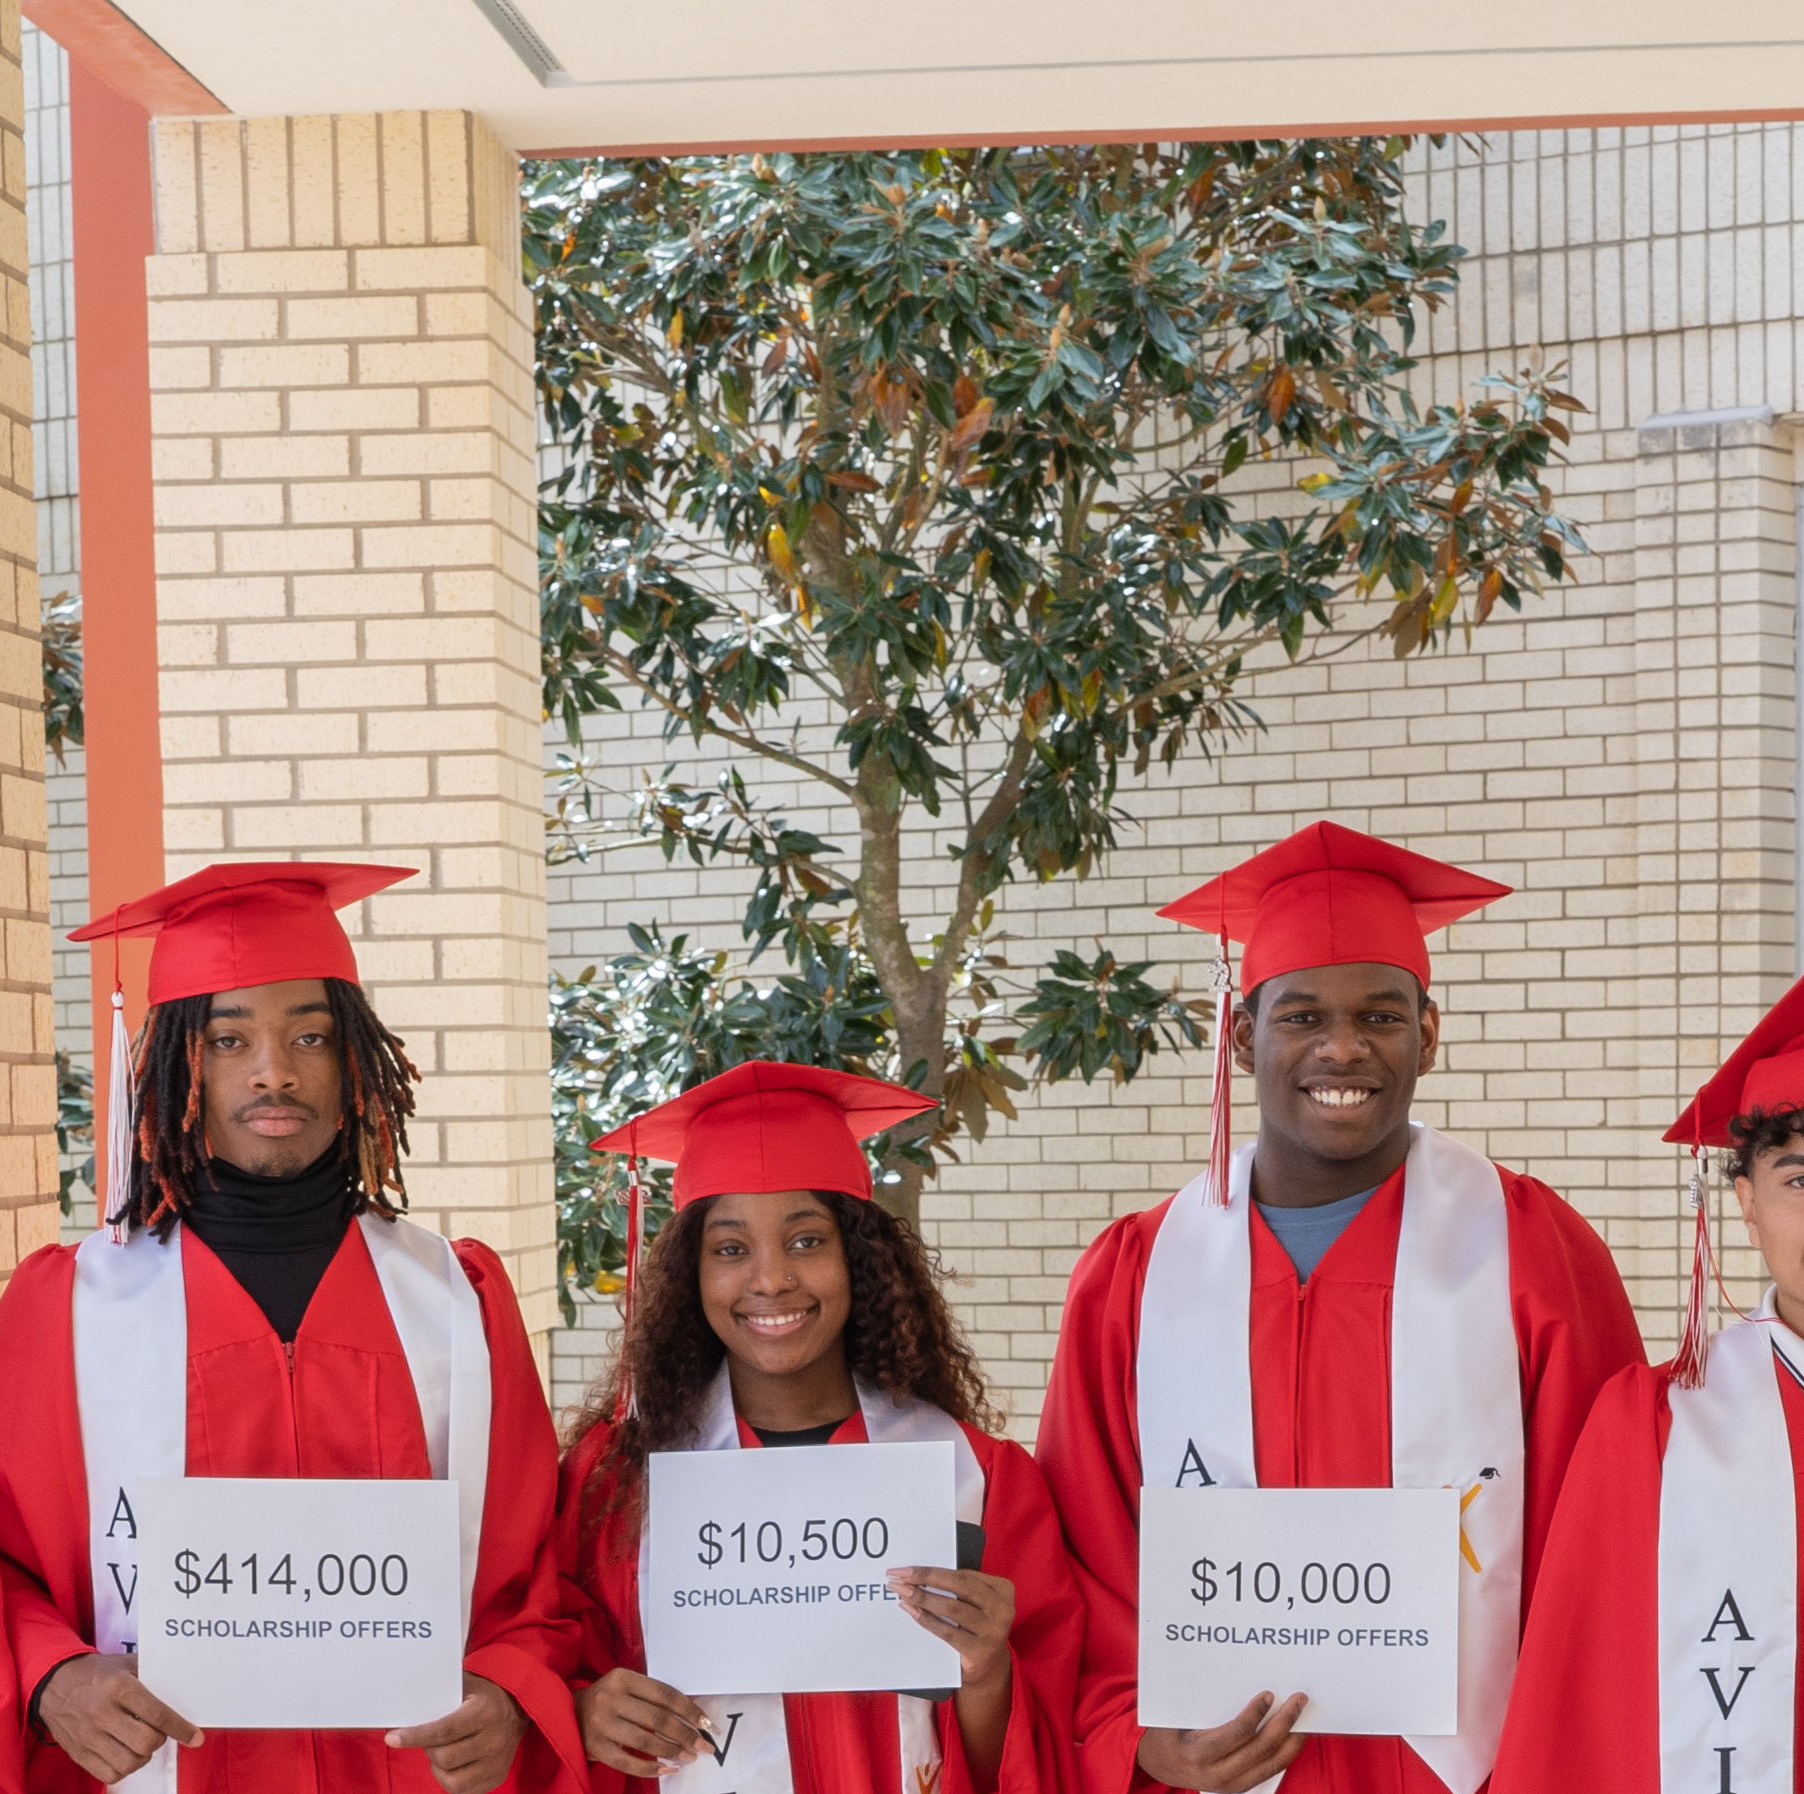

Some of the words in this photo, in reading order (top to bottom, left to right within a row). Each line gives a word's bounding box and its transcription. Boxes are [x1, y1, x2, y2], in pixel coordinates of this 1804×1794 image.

[697, 1517, 889, 1570] $10,500
[173, 1548, 408, 1603] $414,000
[1190, 1556, 1391, 1611] $10,000
[673, 1585, 831, 1608] SCHOLARSHIP
[165, 1618, 333, 1638] SCHOLARSHIP
[339, 1620, 433, 1639] OFFERS
[1165, 1623, 1331, 1646] SCHOLARSHIP
[1337, 1628, 1429, 1647] OFFERS
